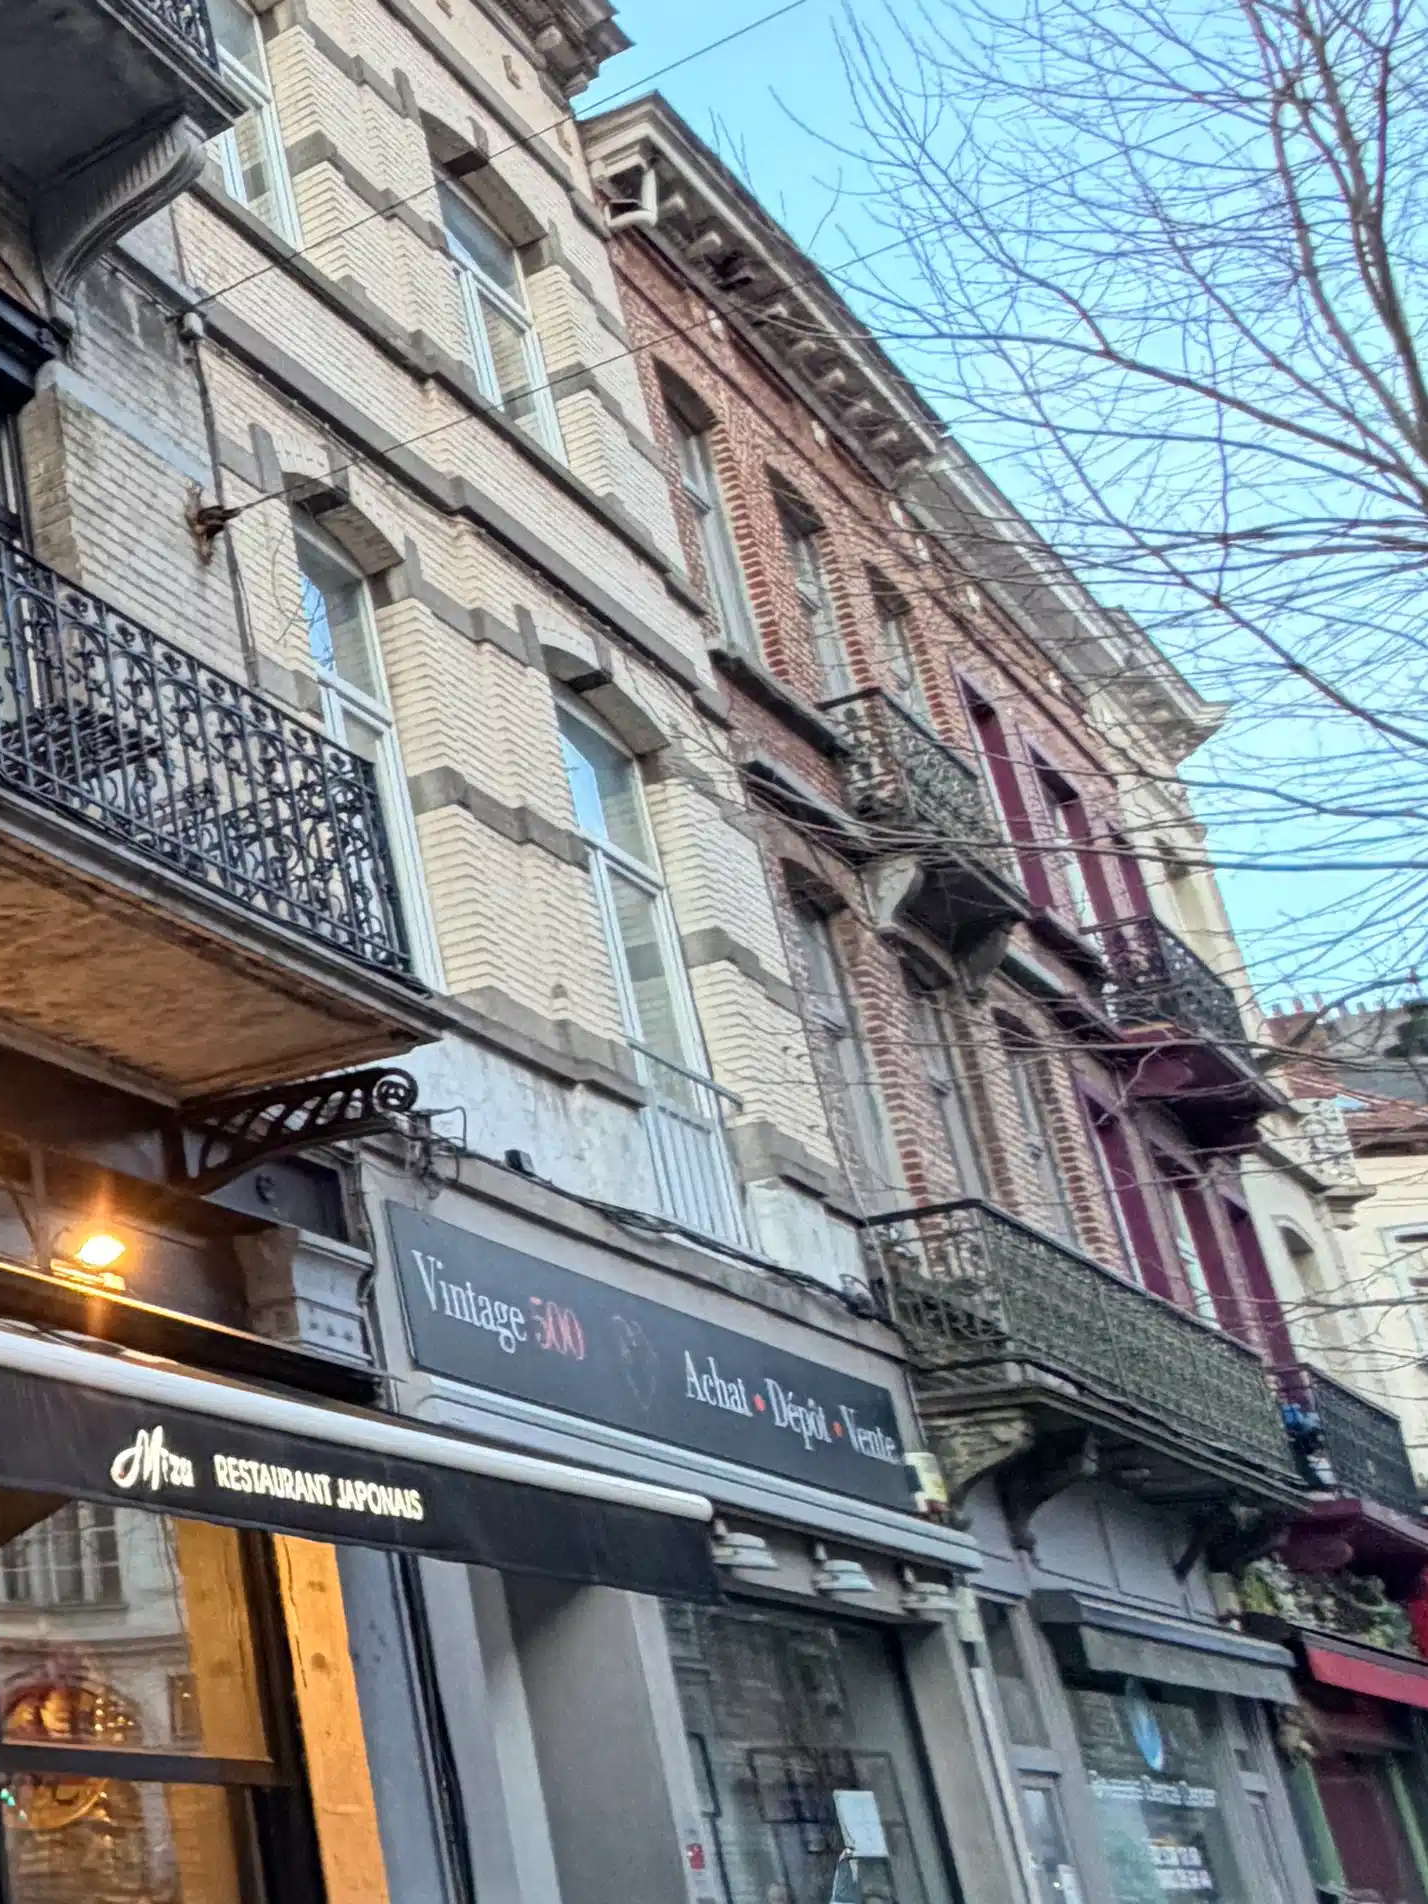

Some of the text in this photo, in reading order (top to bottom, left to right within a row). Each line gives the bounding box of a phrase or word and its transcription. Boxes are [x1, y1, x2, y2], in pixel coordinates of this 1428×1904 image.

[411, 1249, 527, 1354] Vintage
[684, 1350, 901, 1464] Achat Dépôt Vente
[213, 1454, 424, 1520] RESTAURANT JAPONAIS
